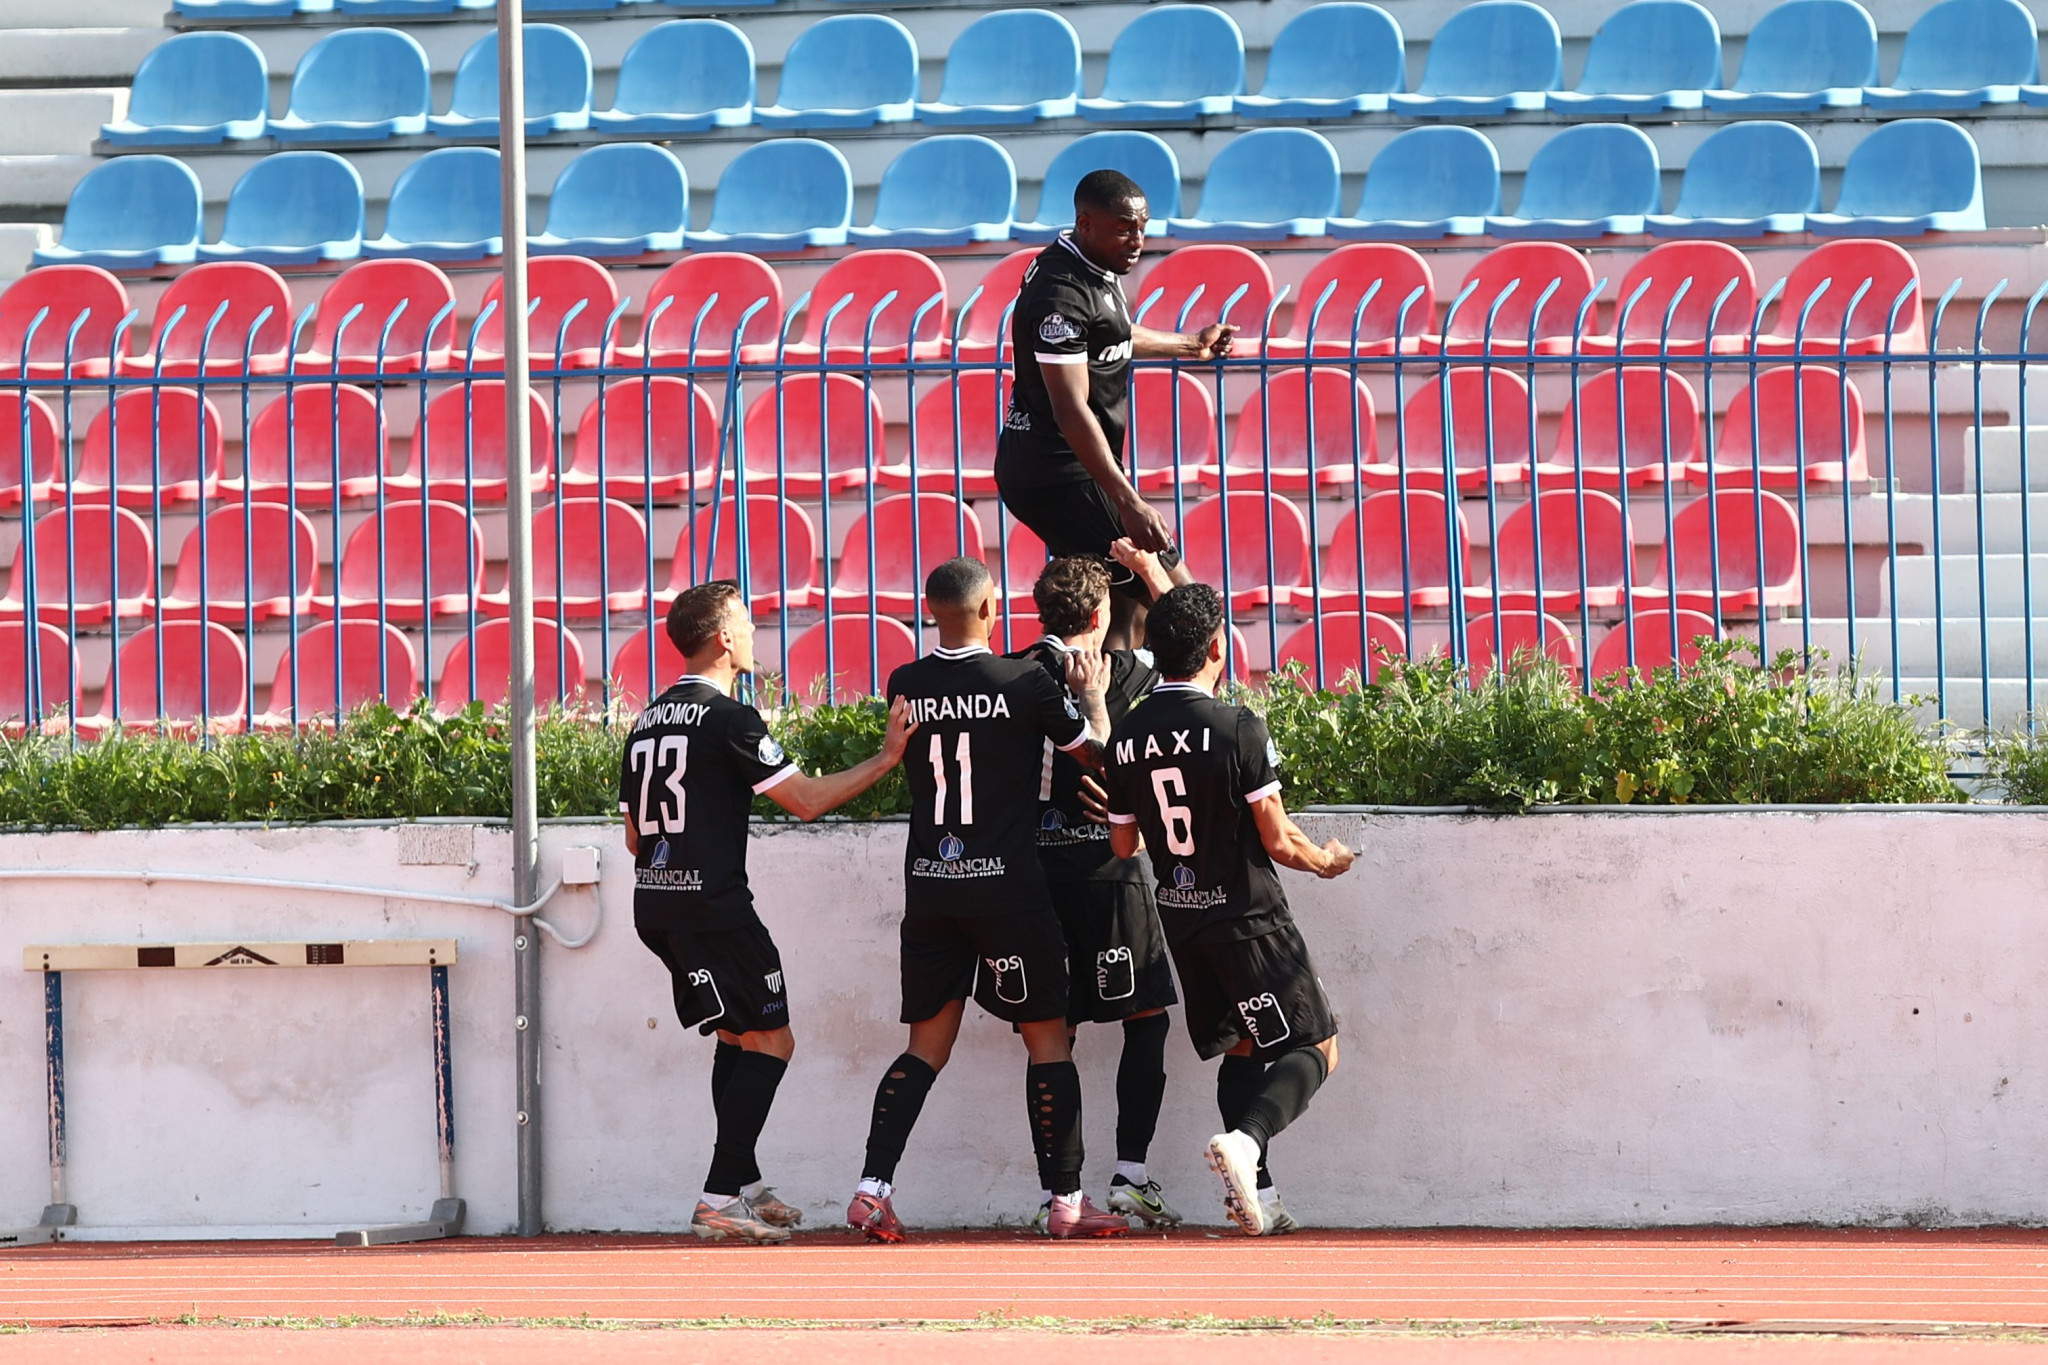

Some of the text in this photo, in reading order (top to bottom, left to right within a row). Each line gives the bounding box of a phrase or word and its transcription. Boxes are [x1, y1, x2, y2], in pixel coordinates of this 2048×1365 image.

[903, 693, 1011, 724] MIRANDA
[1116, 727, 1210, 765] MAXI
[631, 735, 689, 836] 23
[929, 732, 973, 825] 11
[1151, 767, 1195, 856] 6
[642, 869, 703, 884] FINANCIAL
[929, 857, 1005, 874] FINANCIAL
[1168, 885, 1227, 905] FINANCIAL
